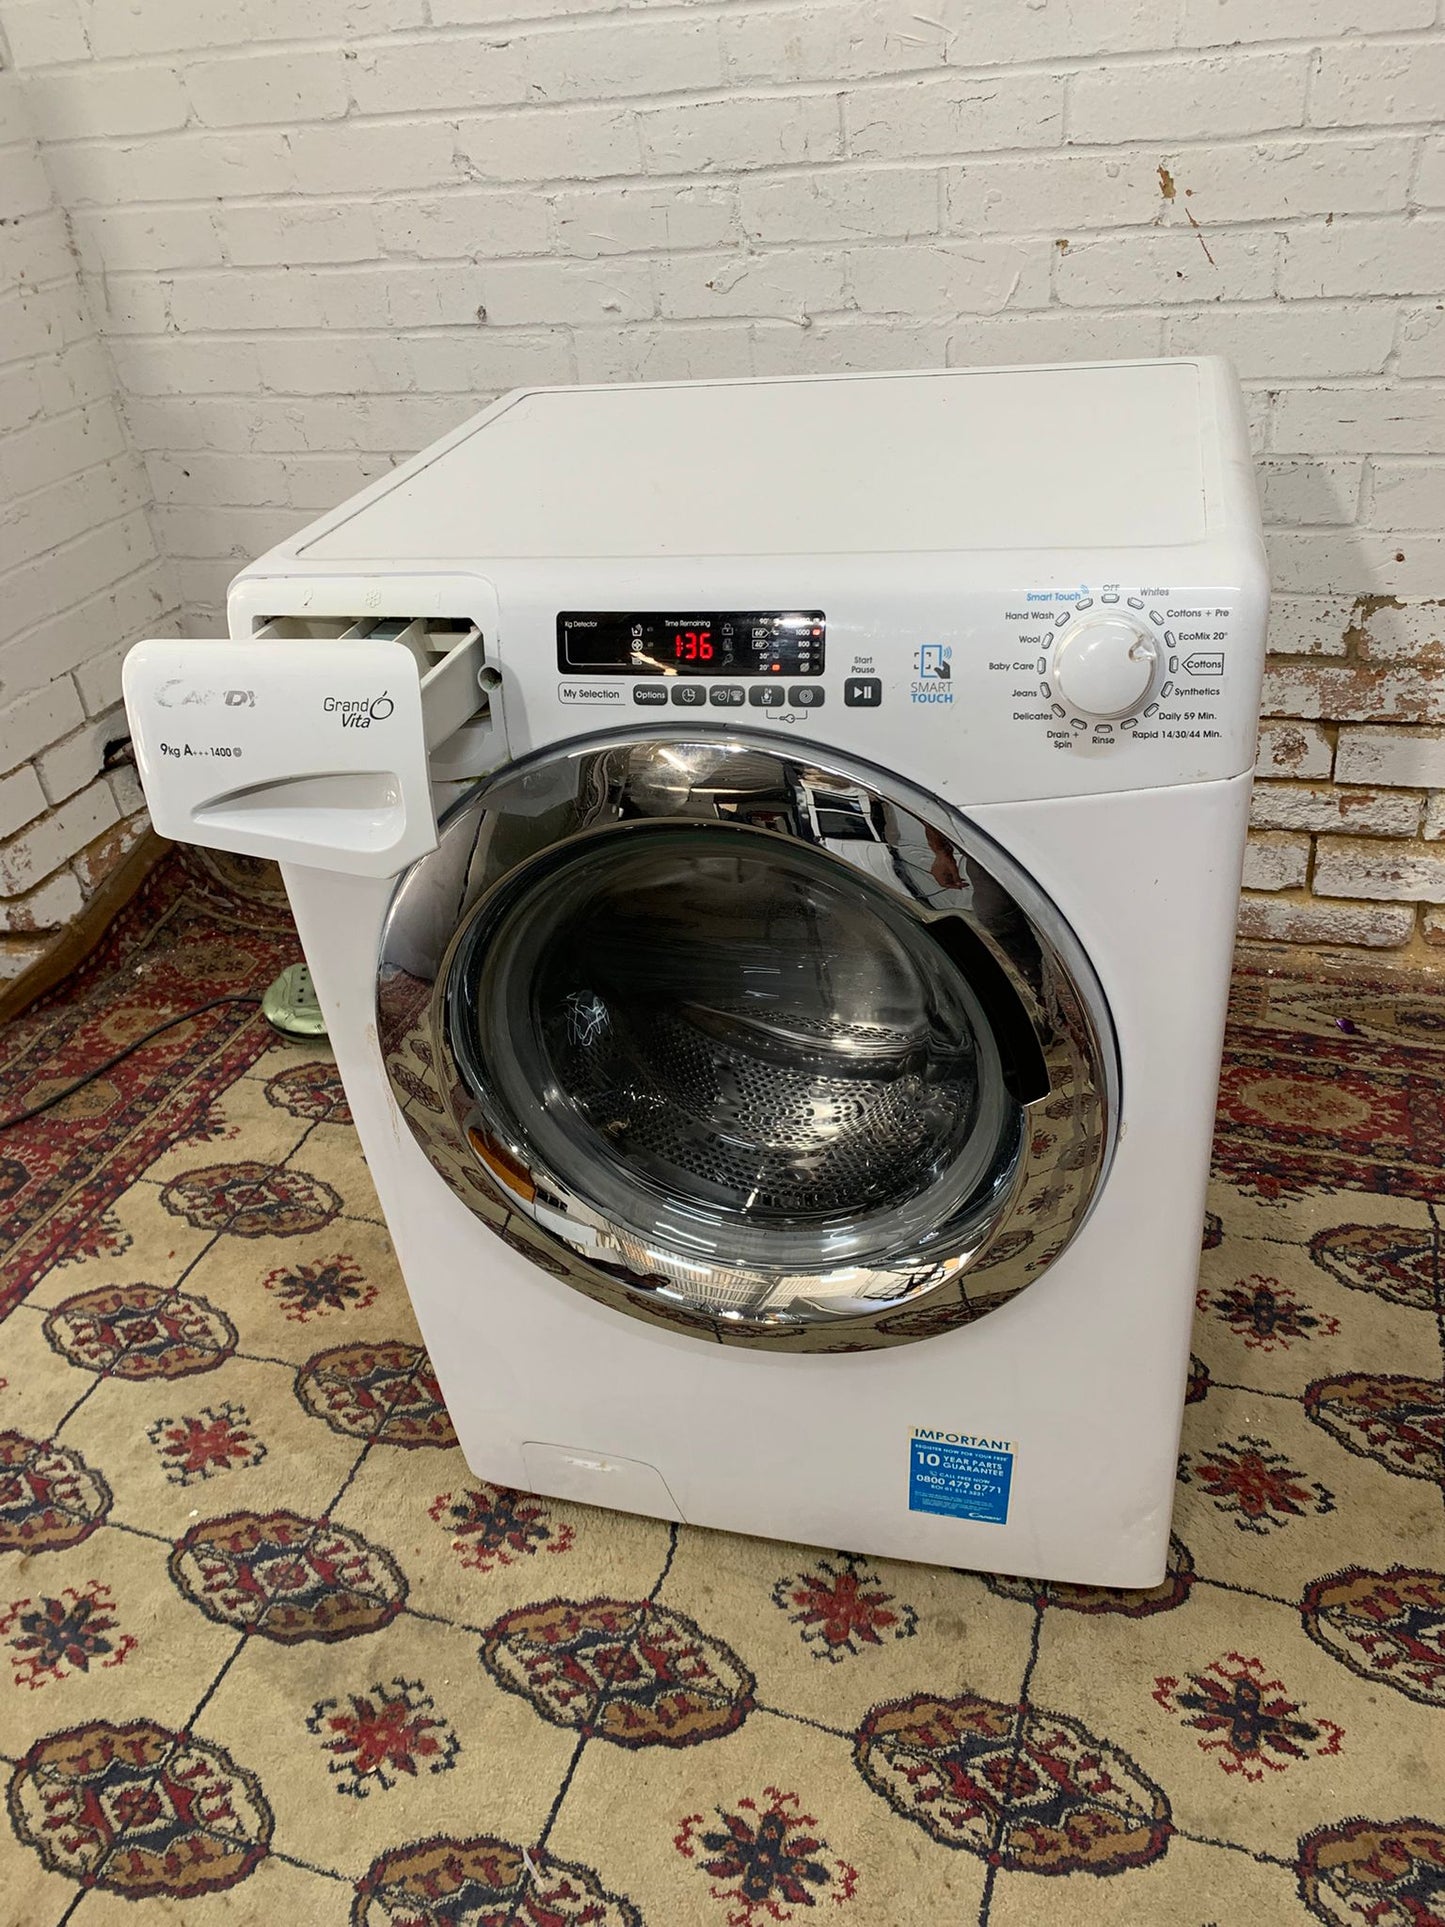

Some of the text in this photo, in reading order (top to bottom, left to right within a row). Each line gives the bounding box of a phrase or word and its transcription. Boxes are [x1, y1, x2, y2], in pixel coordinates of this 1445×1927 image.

[1140, 587, 1169, 596] Whites
[1027, 592, 1081, 601] Smart Touch
[1005, 612, 1054, 620] Hand Wash
[1166, 609, 1201, 618] Cottons
[1215, 609, 1229, 617] Pre
[564, 621, 573, 629] Kg
[680, 620, 711, 628] Remaining
[1019, 635, 1041, 643] Wool
[1178, 632, 1210, 640] EcoMix
[675, 632, 713, 659] 1:36
[854, 656, 873, 664] Start
[989, 662, 1034, 671] Baby Care
[1186, 661, 1221, 669] Cottons
[851, 666, 875, 674] Pause
[911, 682, 953, 692] SMART
[564, 689, 620, 699] My Selection
[635, 691, 665, 700] Options
[1012, 689, 1037, 697] Jeans
[1174, 688, 1220, 697] Synthetics
[911, 694, 953, 703] TOUCH
[323, 697, 369, 712] Grand
[342, 712, 371, 728] Vita
[1013, 712, 1053, 720] Delicates
[1159, 712, 1217, 721] Daily 59 Min.
[1046, 730, 1070, 738] Drain
[1132, 730, 1222, 740] Rapid 14/30/44 Min.
[1054, 740, 1073, 749] Spin
[1092, 736, 1115, 744] Rinse
[160, 743, 181, 758] 9kg
[210, 747, 232, 757] 1400
[915, 1428, 1011, 1451] IMPORTANT
[915, 1443, 942, 1452] REGISTER
[943, 1447, 959, 1455] NOW
[916, 1451, 1003, 1470] 10 YEAR PARTS
[942, 1461, 1004, 1477] GUARANTEE
[916, 1474, 1001, 1494] 0800 479 0771
